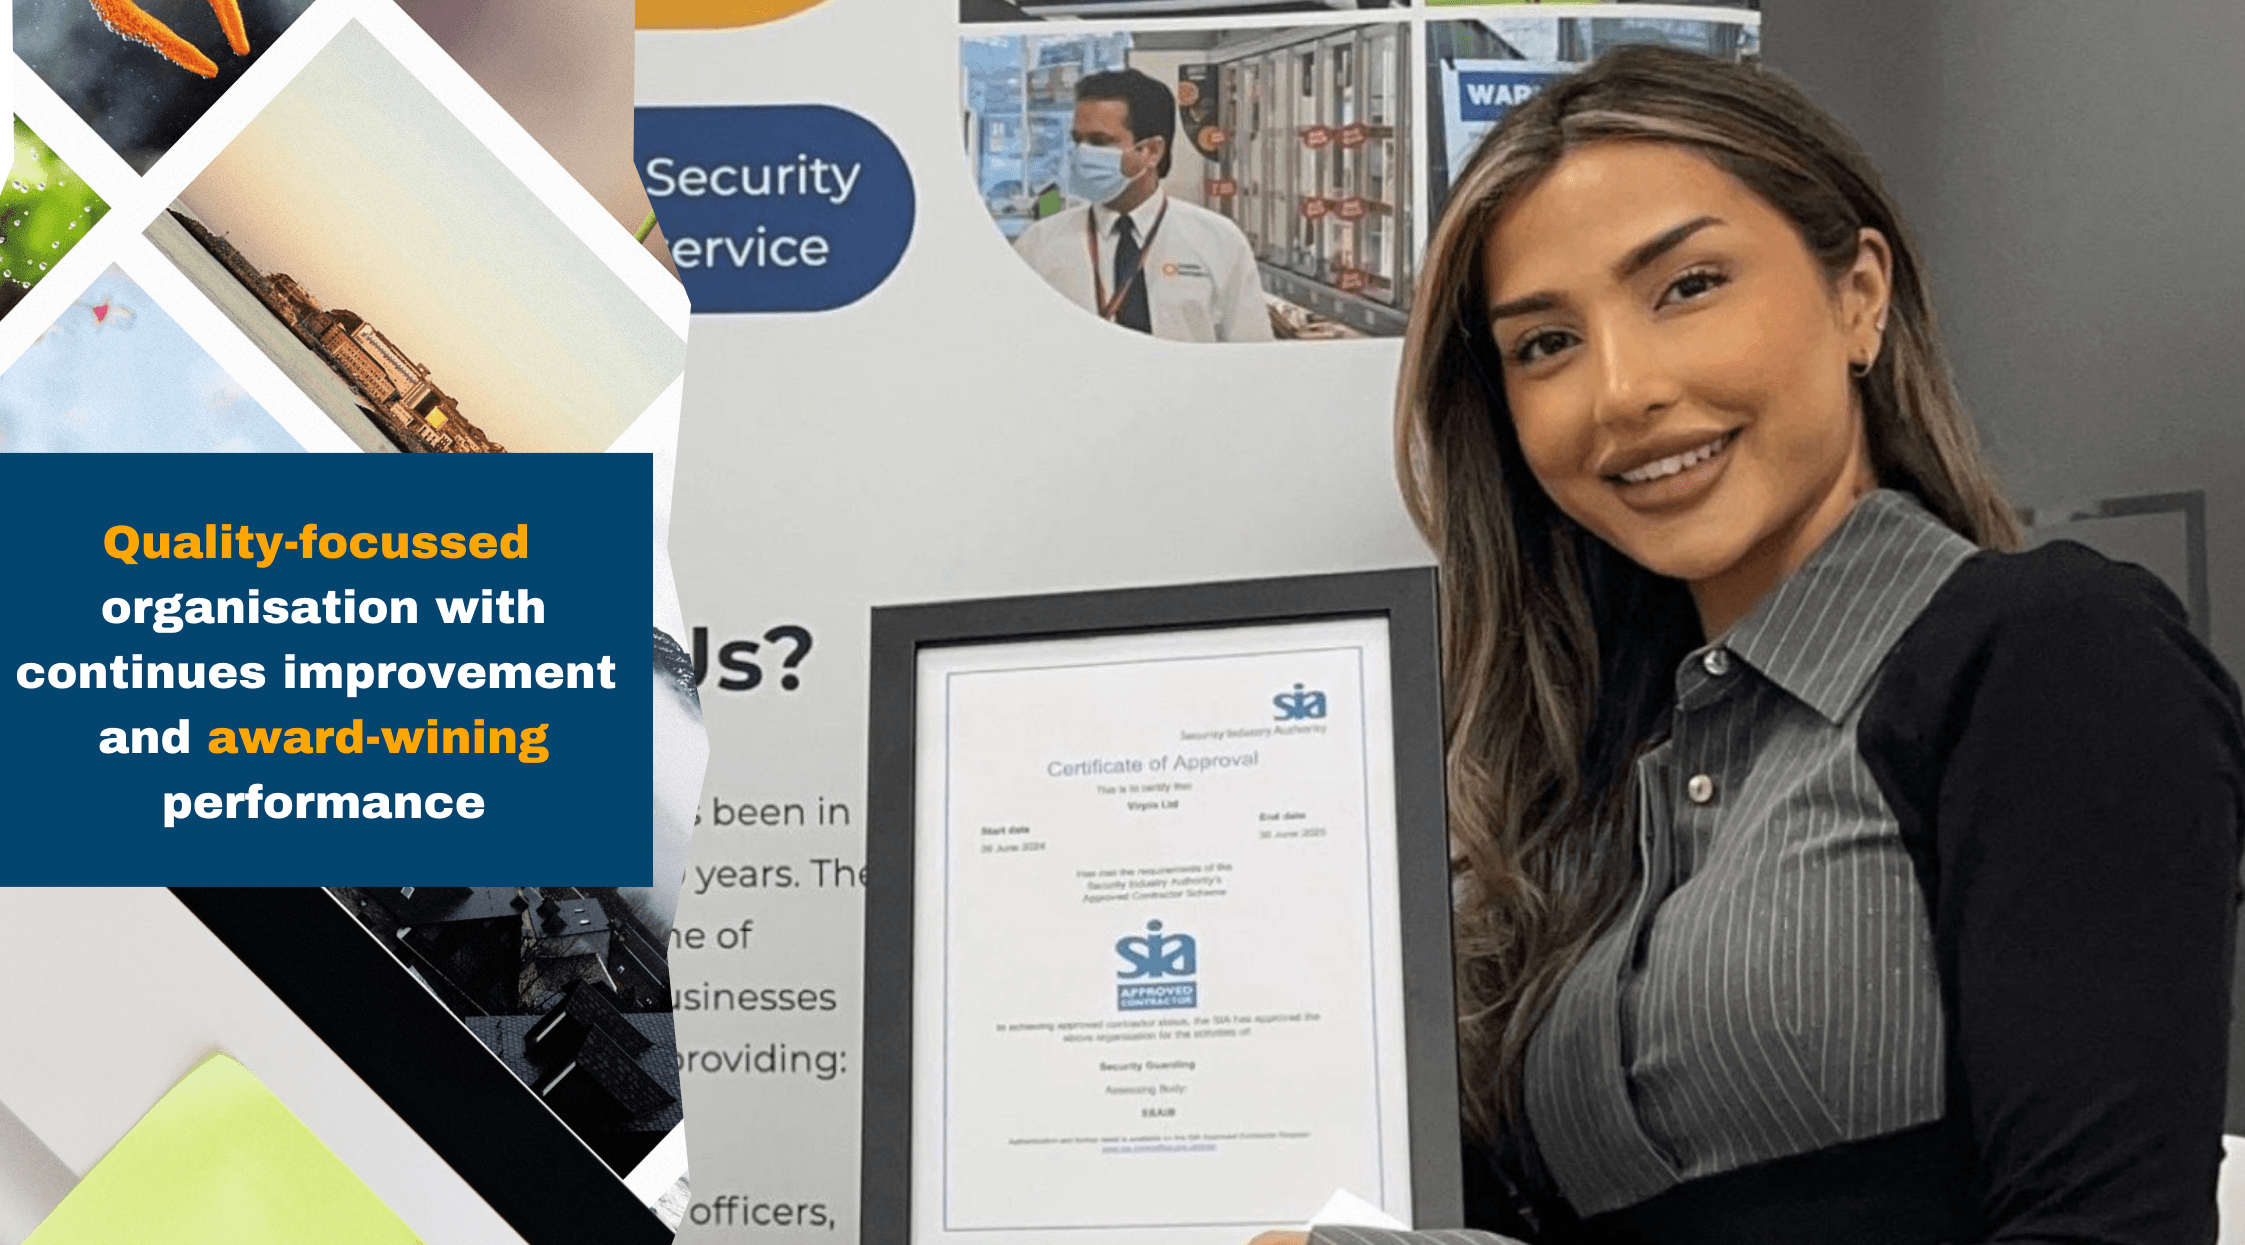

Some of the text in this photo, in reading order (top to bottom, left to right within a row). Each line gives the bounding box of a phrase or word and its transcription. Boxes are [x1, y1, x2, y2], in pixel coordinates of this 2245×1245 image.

[646, 153, 861, 205] Security
[667, 225, 830, 268] ervice
[1273, 683, 1327, 721] sia
[1047, 750, 1259, 777] Certificate of Approval
[713, 796, 804, 826] been
[818, 796, 850, 826] in
[1259, 811, 1280, 821] End
[981, 825, 1030, 836] Start date
[694, 864, 800, 895] years.
[716, 919, 753, 950] of
[1115, 918, 1197, 979] sia
[1121, 985, 1194, 998] APPROVED
[1099, 1061, 1142, 1071] Security
[689, 1195, 835, 1230] officers,
